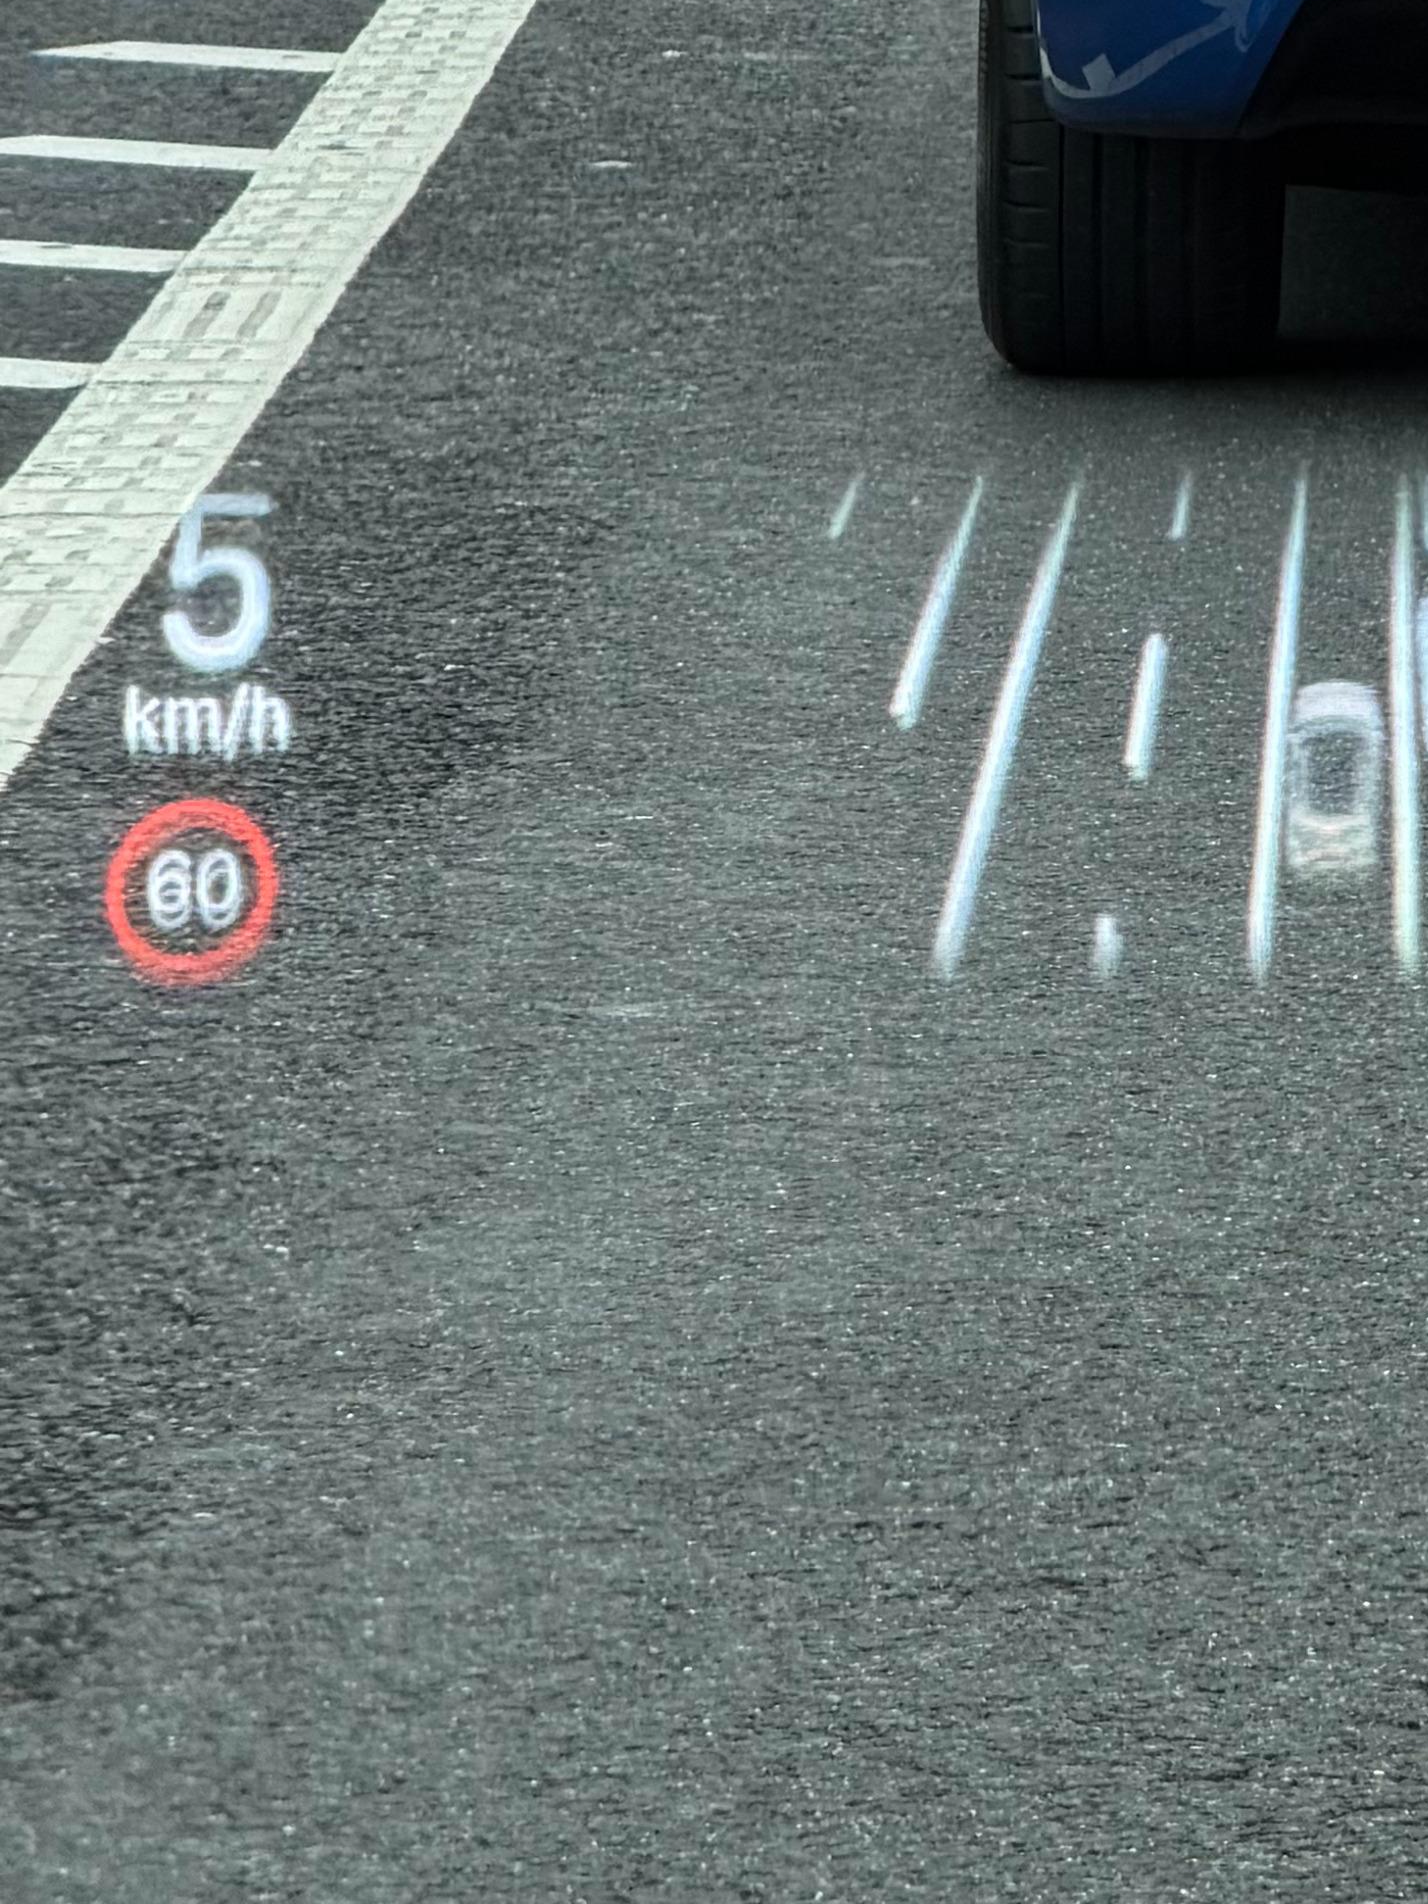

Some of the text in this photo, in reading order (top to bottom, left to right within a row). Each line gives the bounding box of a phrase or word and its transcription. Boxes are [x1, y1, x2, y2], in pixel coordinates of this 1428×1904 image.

[161, 492, 277, 674] 5
[122, 682, 296, 762] km/h
[146, 846, 247, 933] 60
